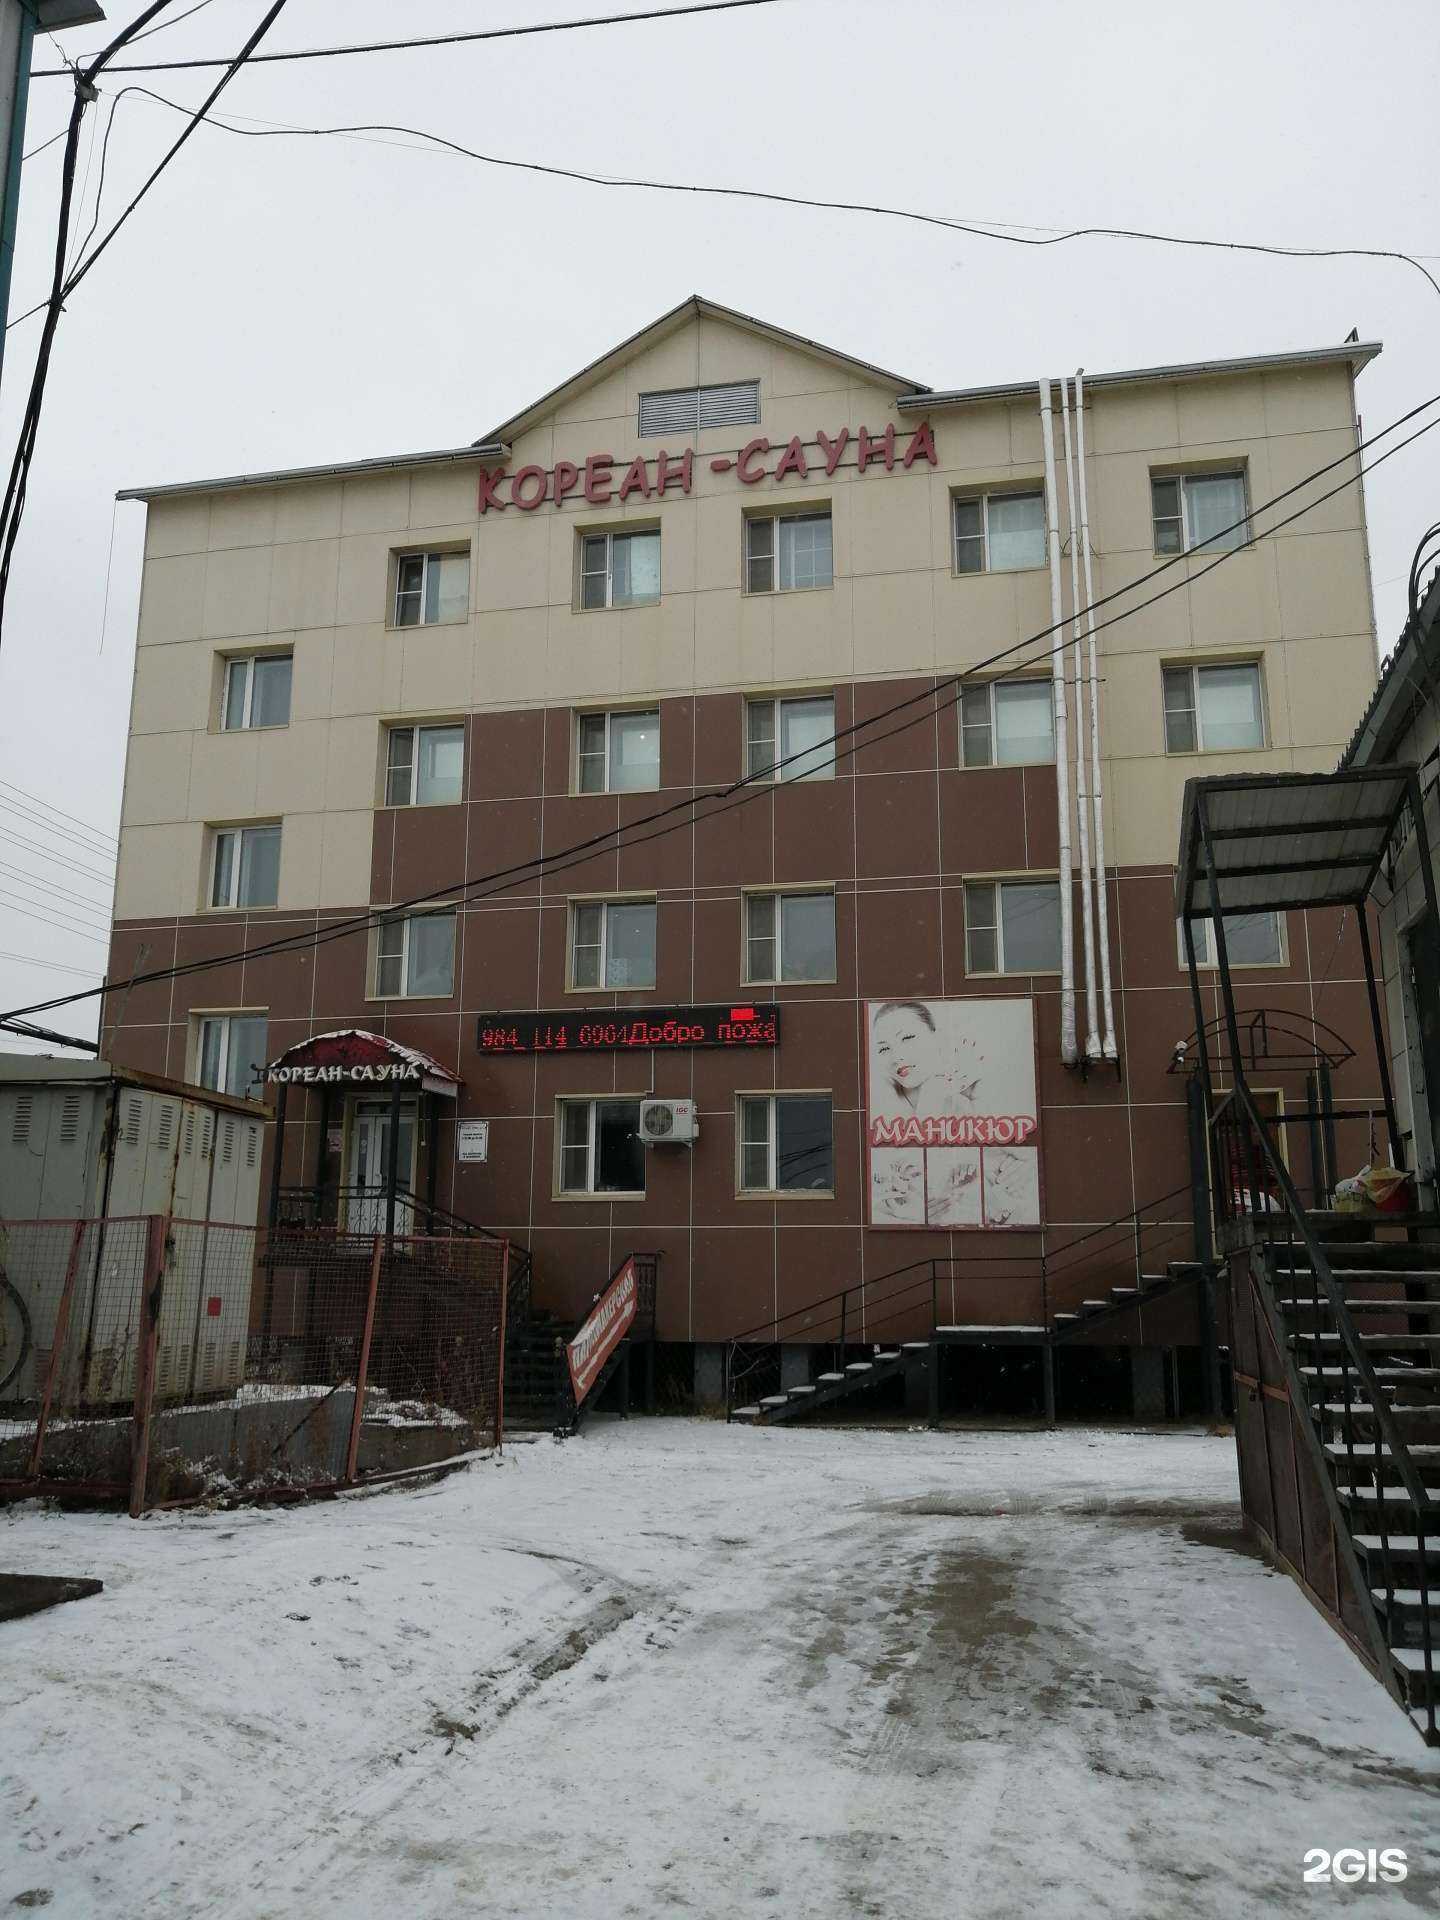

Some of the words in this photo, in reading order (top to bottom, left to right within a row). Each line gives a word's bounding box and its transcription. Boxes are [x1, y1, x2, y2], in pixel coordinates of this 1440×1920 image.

[478, 447, 694, 514] КОРЕАН
[267, 1062, 420, 1083] КОРЕАН-САУНА
[873, 1115, 1037, 1146] МАНИКЮР
